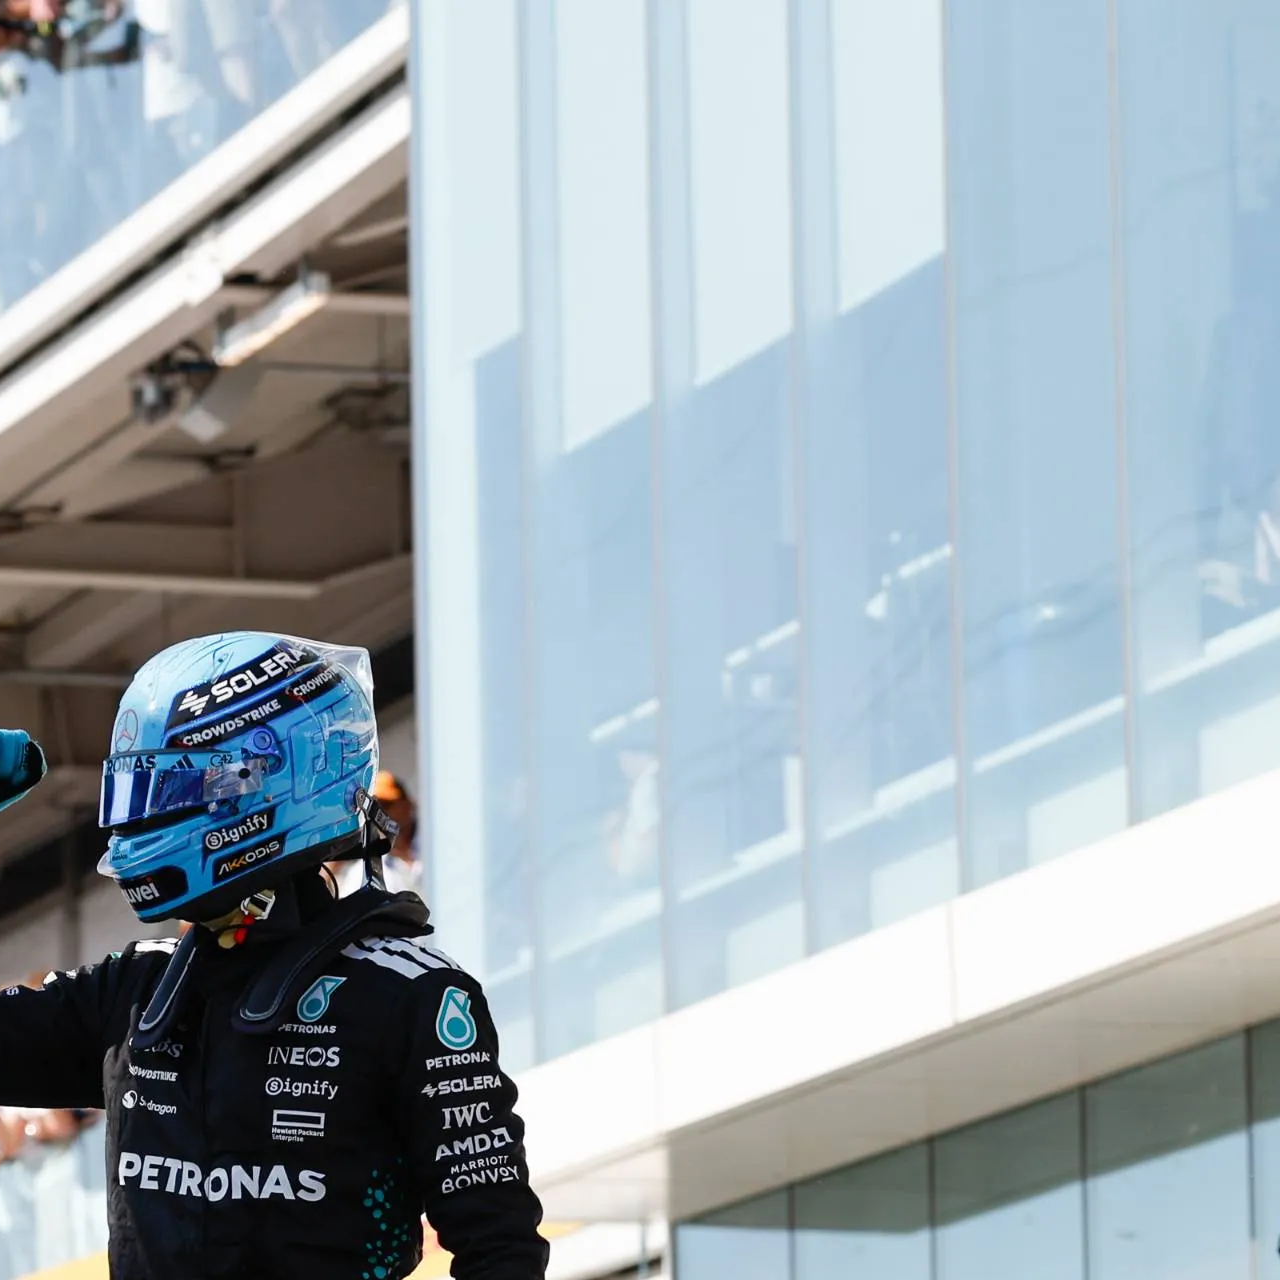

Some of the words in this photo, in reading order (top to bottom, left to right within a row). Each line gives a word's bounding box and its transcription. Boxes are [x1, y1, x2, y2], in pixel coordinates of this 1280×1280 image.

[210, 645, 308, 704] SOLERA
[183, 699, 282, 747] CROWDSTRIKE
[205, 813, 268, 850] signify
[268, 1046, 341, 1067] INEOS
[425, 1051, 491, 1070] PETRONA
[265, 1076, 338, 1100] signify
[438, 1074, 503, 1096] SOLERA
[441, 1102, 494, 1130] IWC
[435, 1132, 492, 1162] AMD
[118, 1151, 327, 1202] PETRONAS
[441, 1165, 521, 1194] BONVOY
[450, 1156, 509, 1175] MARRIOTT
